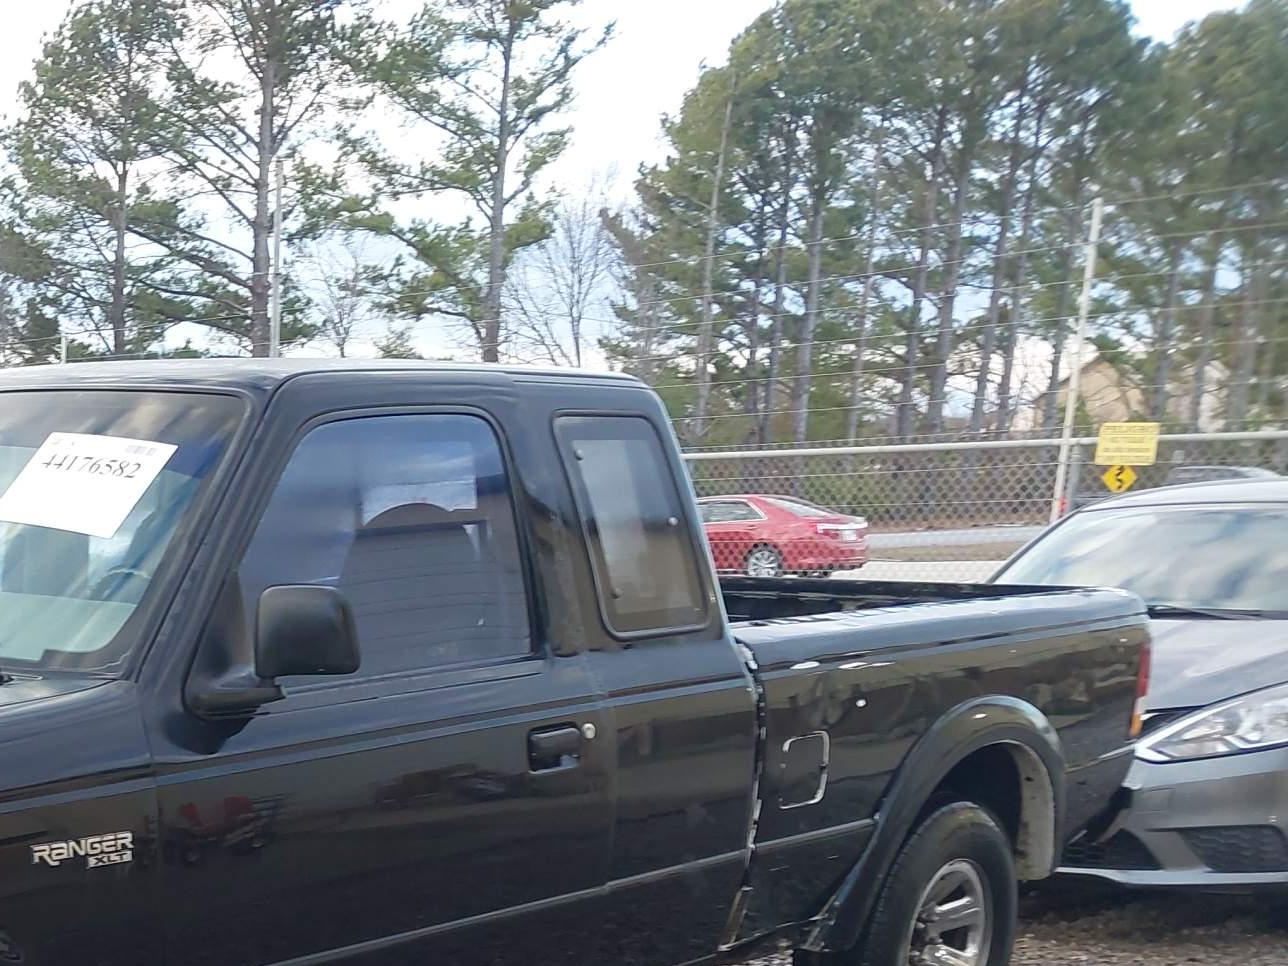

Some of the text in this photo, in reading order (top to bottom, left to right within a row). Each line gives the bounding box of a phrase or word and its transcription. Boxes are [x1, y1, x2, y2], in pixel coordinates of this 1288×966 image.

[42, 453, 142, 479] 44176582
[30, 830, 134, 867] RANGER
[89, 851, 132, 867] XLT
